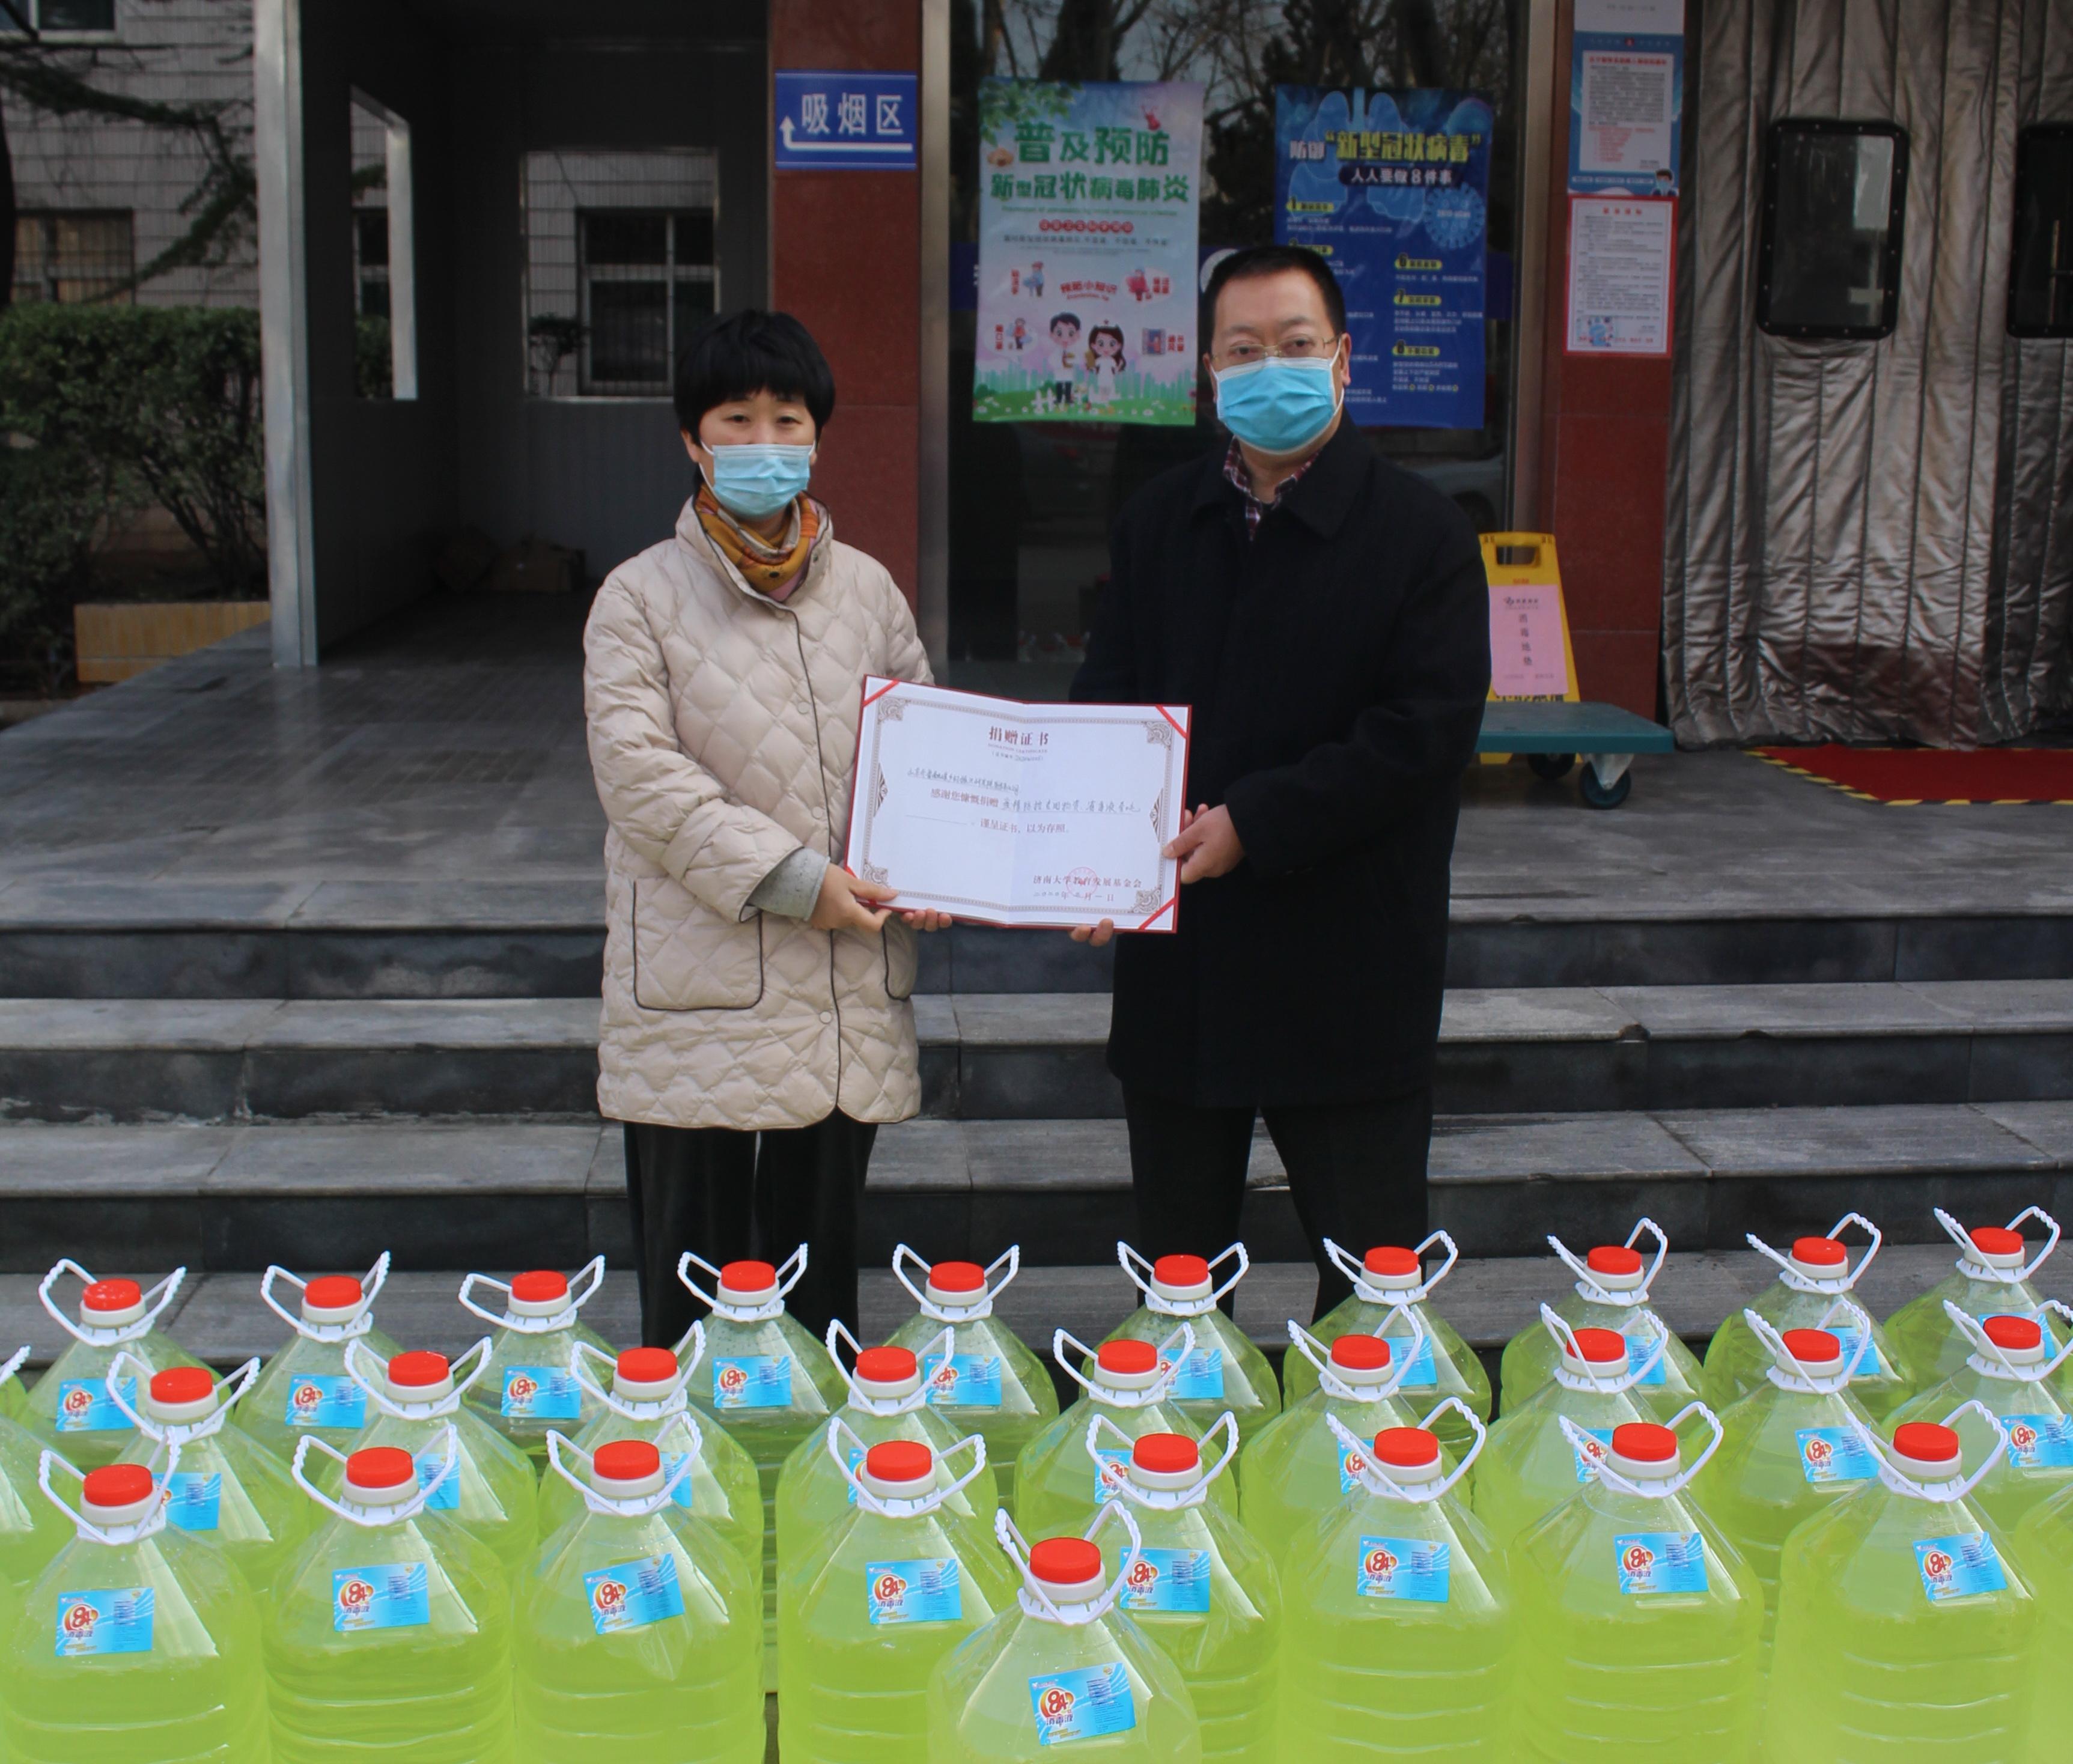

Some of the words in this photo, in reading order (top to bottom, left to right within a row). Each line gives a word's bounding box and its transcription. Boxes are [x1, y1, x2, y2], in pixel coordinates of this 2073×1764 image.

[801, 93, 904, 135] 吸烟区
[1015, 121, 1169, 165] 普及预防
[991, 171, 1189, 202] 新型冠状病毒肺炎
[989, 726, 1049, 746] 捐赠证书
[931, 788, 999, 807] 感谢您慷慨捐赠
[516, 1379, 531, 1396] 84
[726, 1369, 742, 1386] 84
[72, 1389, 87, 1409] 84
[302, 1385, 317, 1405] 84
[2017, 1426, 2031, 1444] 84
[1812, 1440, 1827, 1458] 84
[1372, 1552, 1392, 1572] 84
[1630, 1548, 1649, 1568] 84
[1929, 1553, 1947, 1573] 84
[1134, 1563, 1152, 1583] 84
[349, 1583, 367, 1604] 84
[602, 1583, 621, 1604] 84
[881, 1577, 901, 1598] 84
[72, 1607, 92, 1628] 84
[1047, 1690, 1068, 1714] 84
